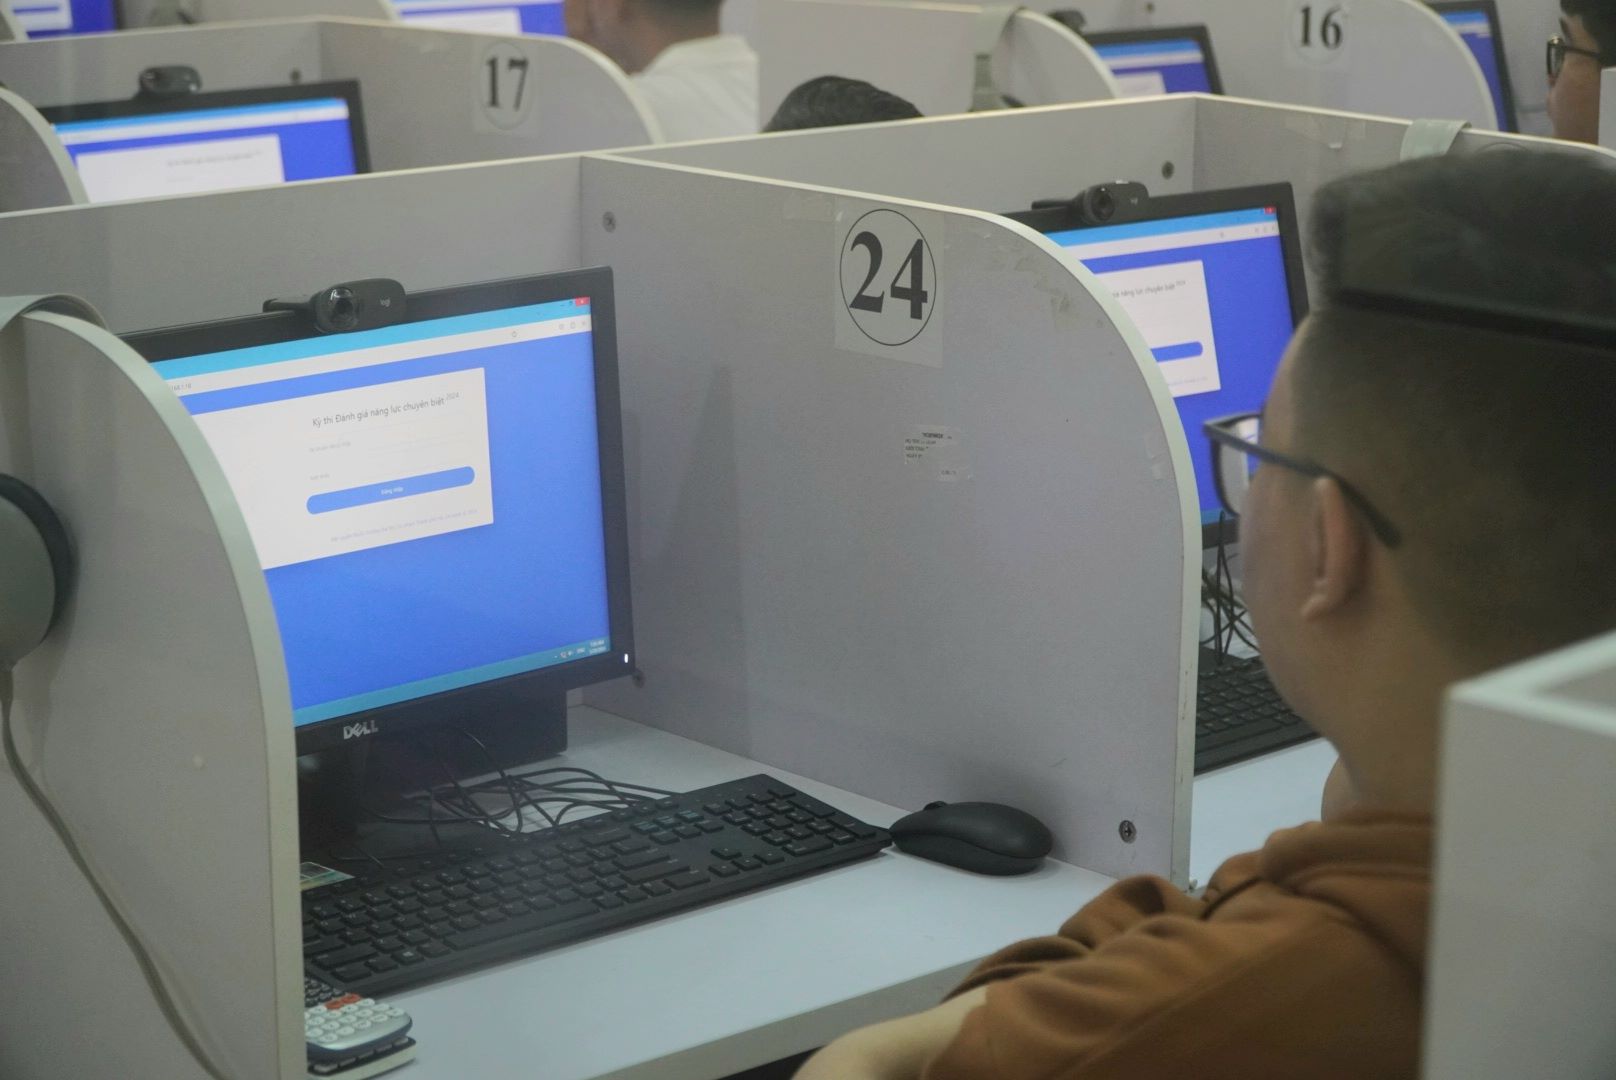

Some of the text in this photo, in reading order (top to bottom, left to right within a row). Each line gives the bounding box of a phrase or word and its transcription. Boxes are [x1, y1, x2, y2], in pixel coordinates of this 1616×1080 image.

[1300, 4, 1343, 50] 16
[486, 56, 529, 112] 17
[849, 231, 928, 321] 24
[323, 416, 334, 425] thi
[335, 412, 356, 423] Đánh
[357, 411, 369, 422] giá
[370, 406, 389, 417] năng
[390, 404, 401, 415] lực
[403, 399, 429, 412] chuyên
[343, 719, 379, 740] DELL
